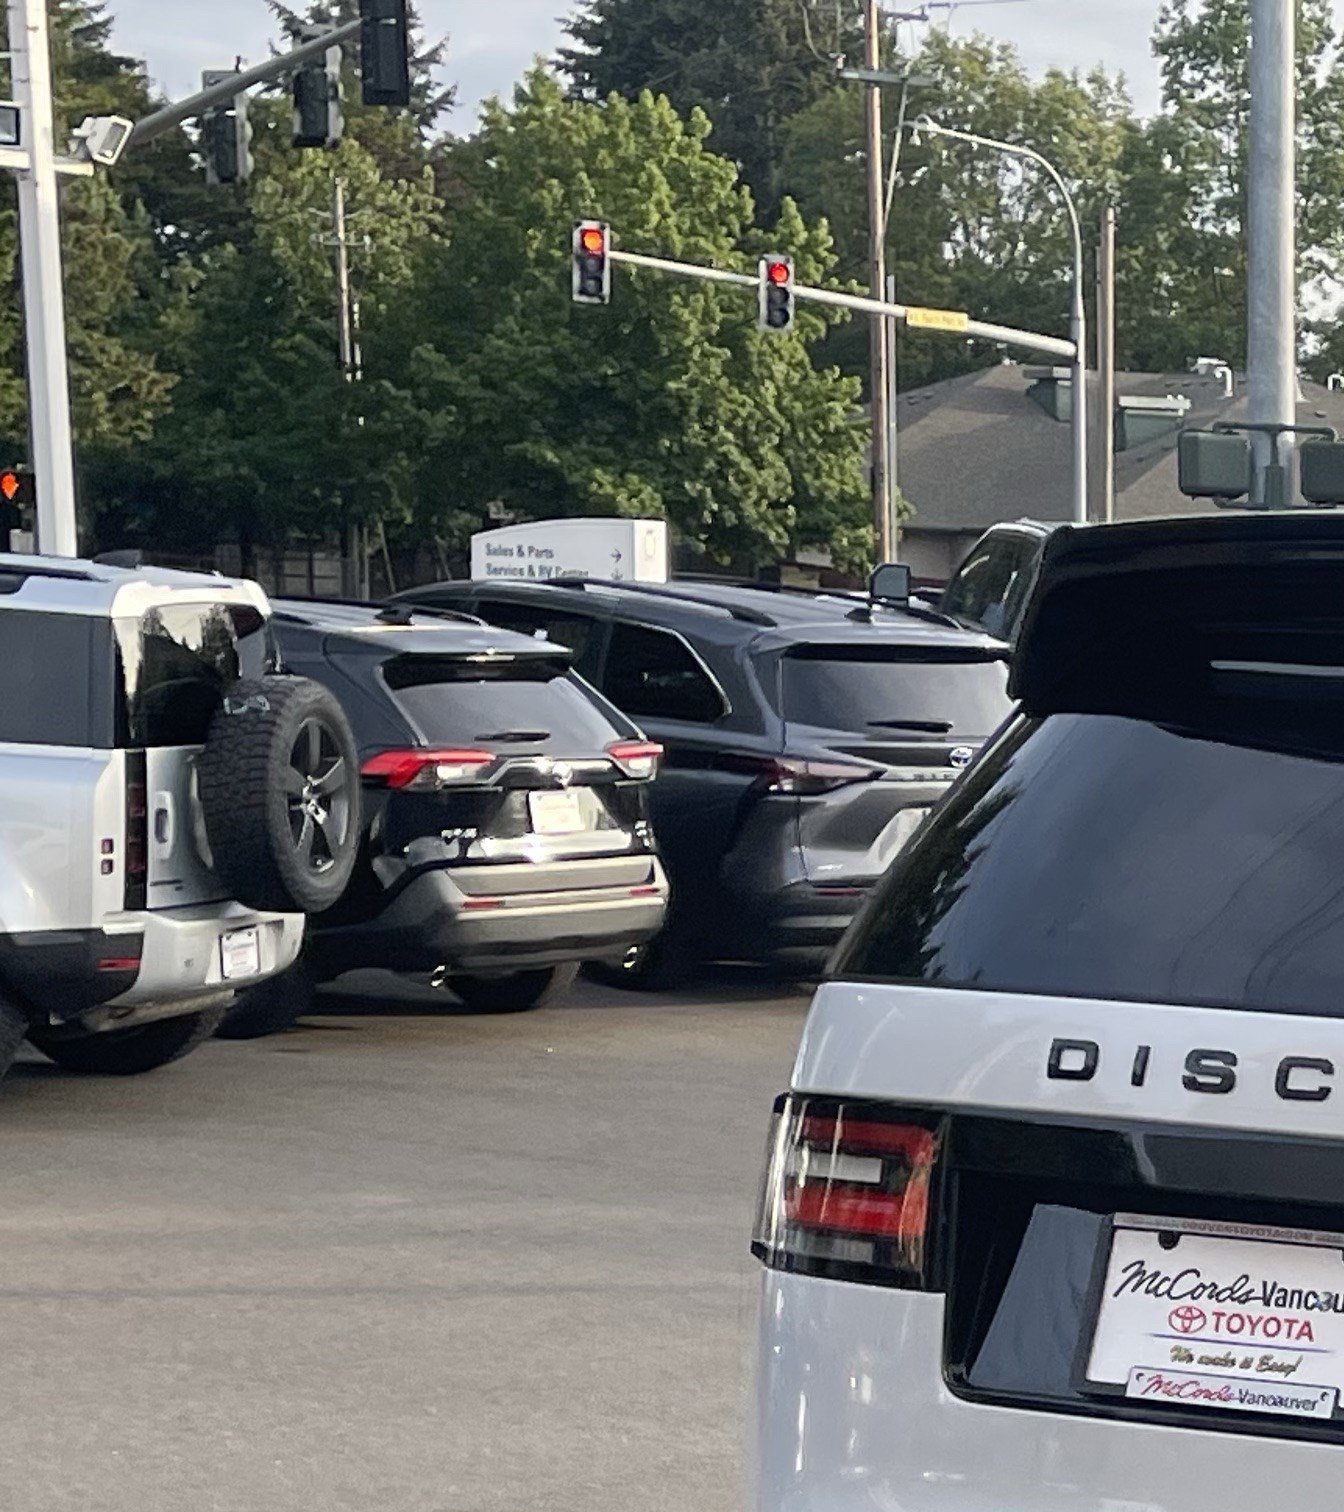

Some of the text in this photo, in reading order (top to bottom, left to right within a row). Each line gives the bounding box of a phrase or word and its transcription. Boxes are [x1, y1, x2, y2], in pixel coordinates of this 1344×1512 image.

[485, 542, 555, 559] Sales & Parts
[485, 562, 525, 577] Service
[527, 564, 536, 578] &
[1211, 1310, 1316, 1343] TOYOTA
